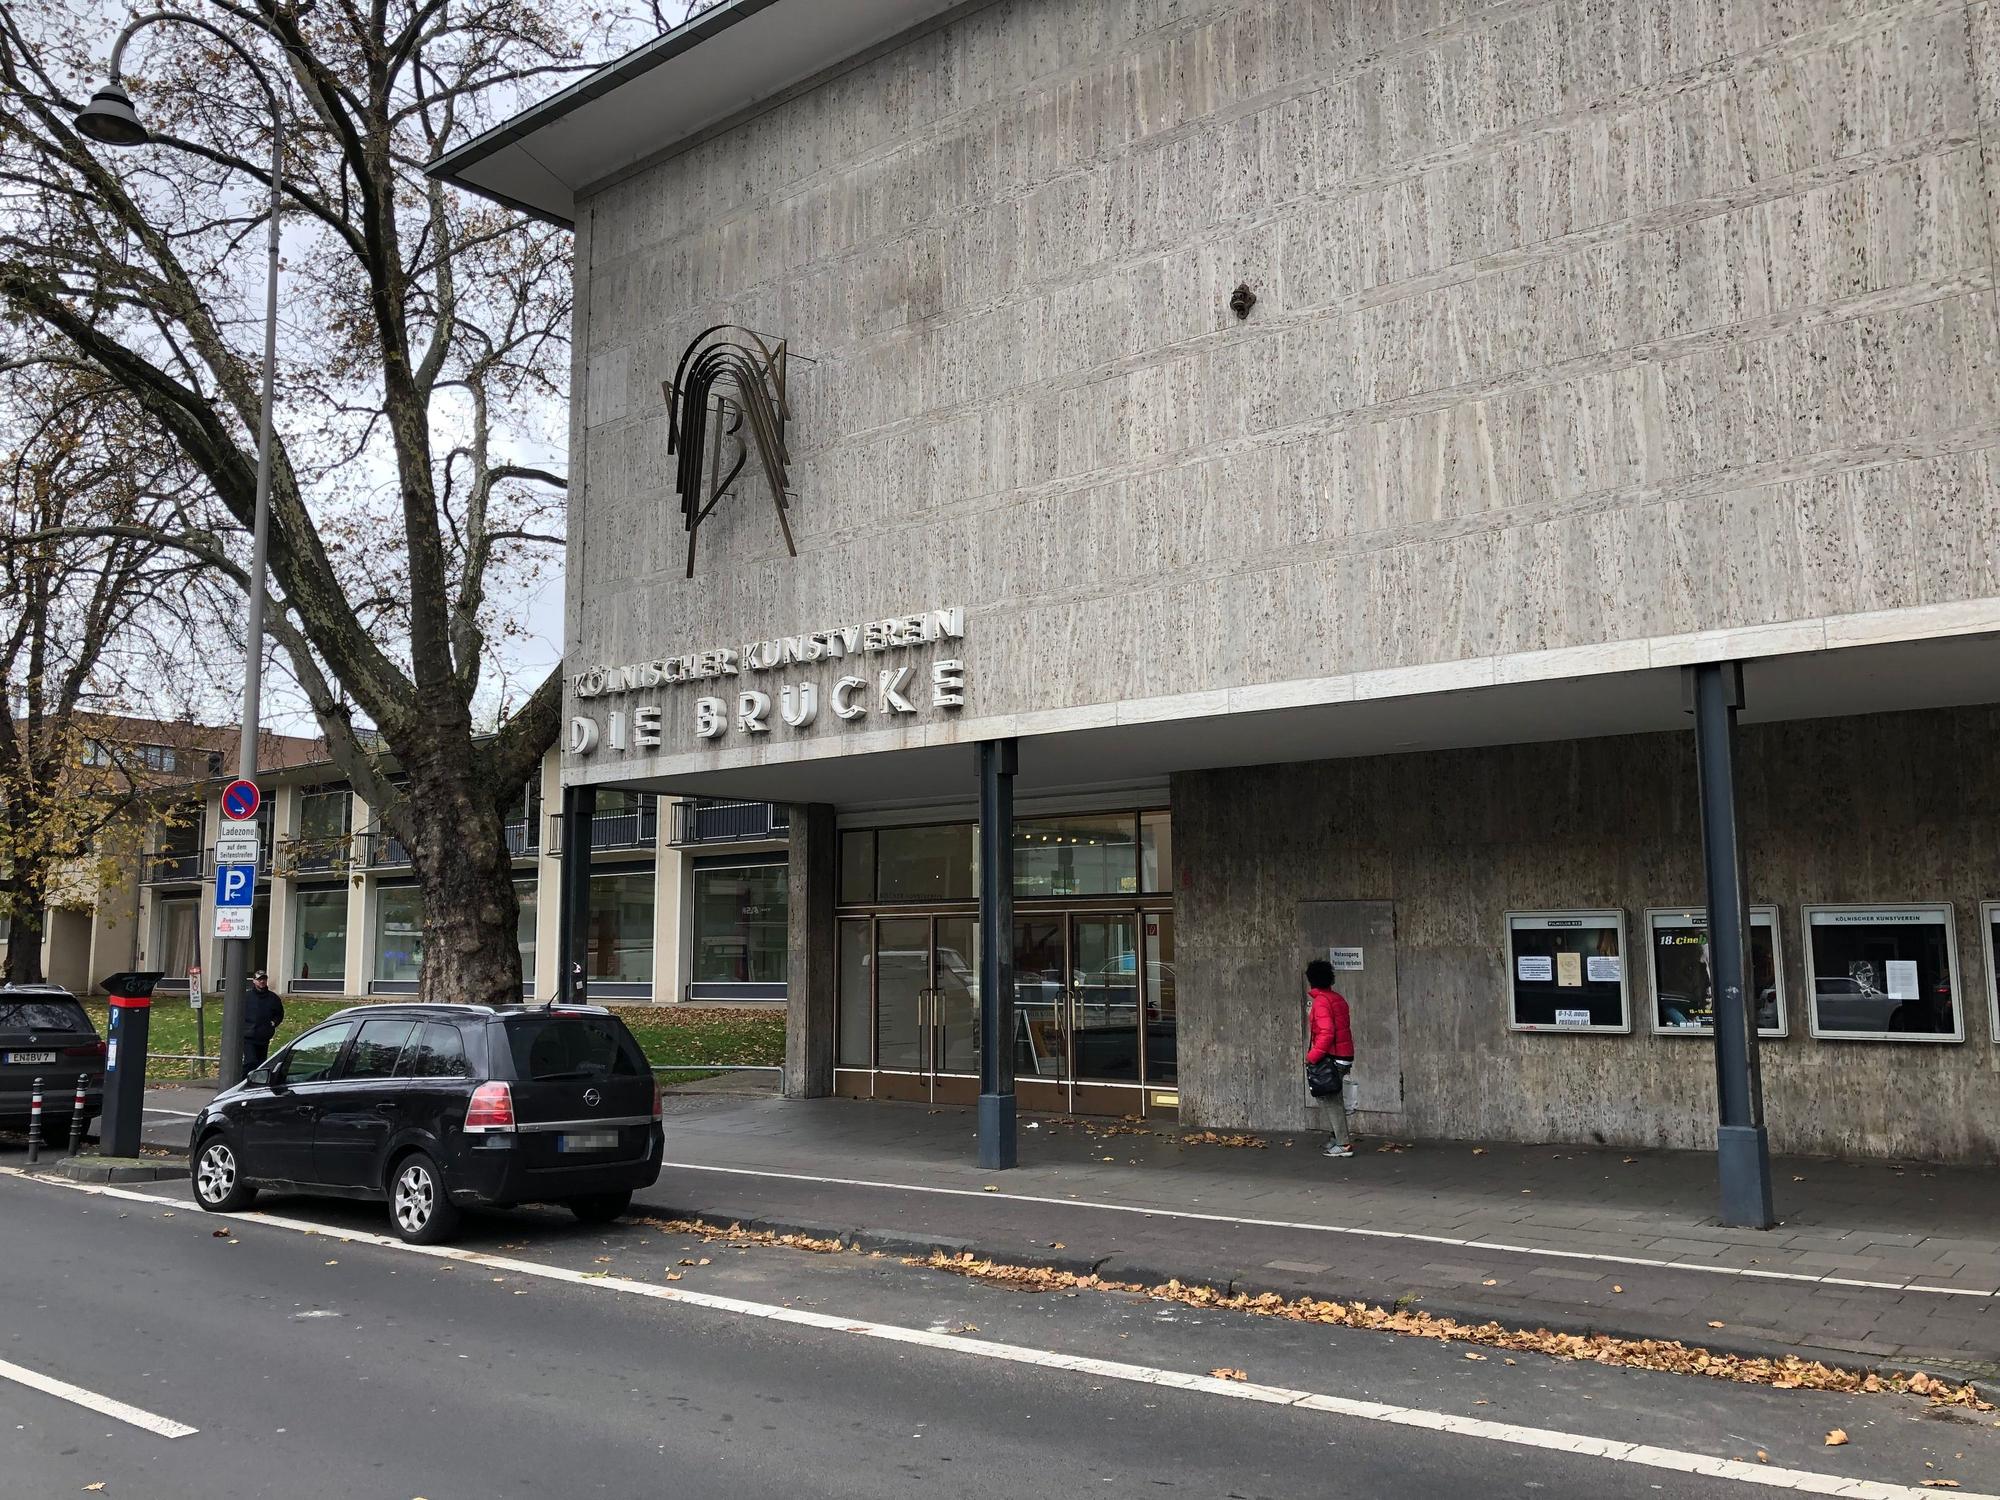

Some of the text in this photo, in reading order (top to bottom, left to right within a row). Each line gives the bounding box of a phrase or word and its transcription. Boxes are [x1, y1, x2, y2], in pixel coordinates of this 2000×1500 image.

[572, 606, 964, 698] KÖLNISCHER KUNSTVEREIN
[569, 706, 662, 755] DIE
[222, 827, 255, 836] Ladezone
[224, 870, 246, 901] P
[112, 1008, 118, 1023] P
[13, 1053, 26, 1061] EN
